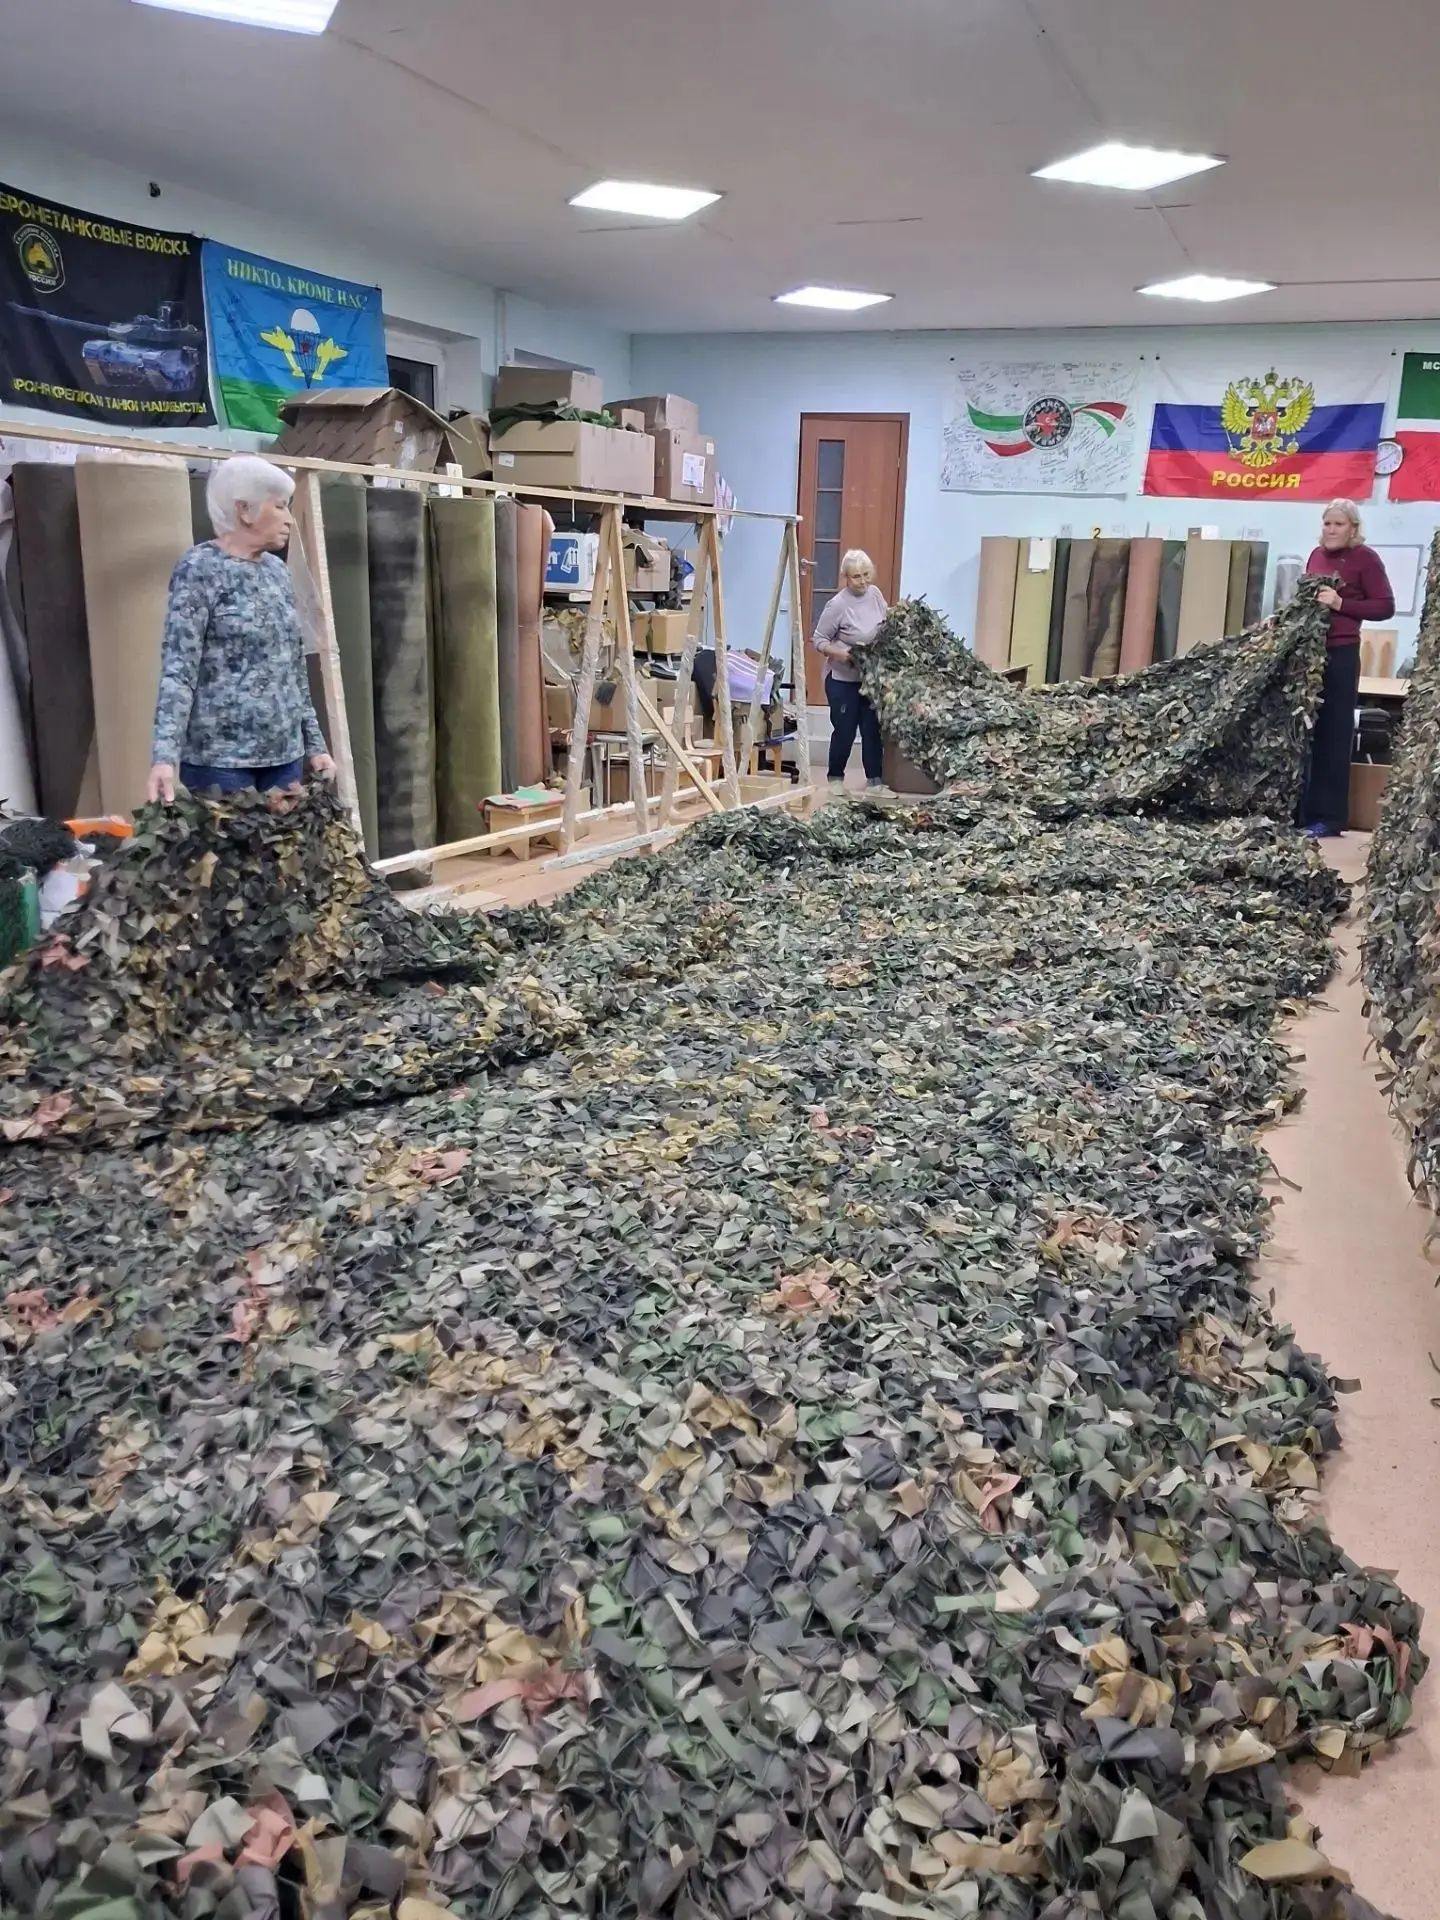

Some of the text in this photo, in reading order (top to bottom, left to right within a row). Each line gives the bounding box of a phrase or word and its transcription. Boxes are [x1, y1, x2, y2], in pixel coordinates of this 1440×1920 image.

[135, 232, 191, 256] ВОЙСКА
[287, 276, 335, 304] КРОМЕ
[1211, 470, 1301, 488] РОССИЯ
